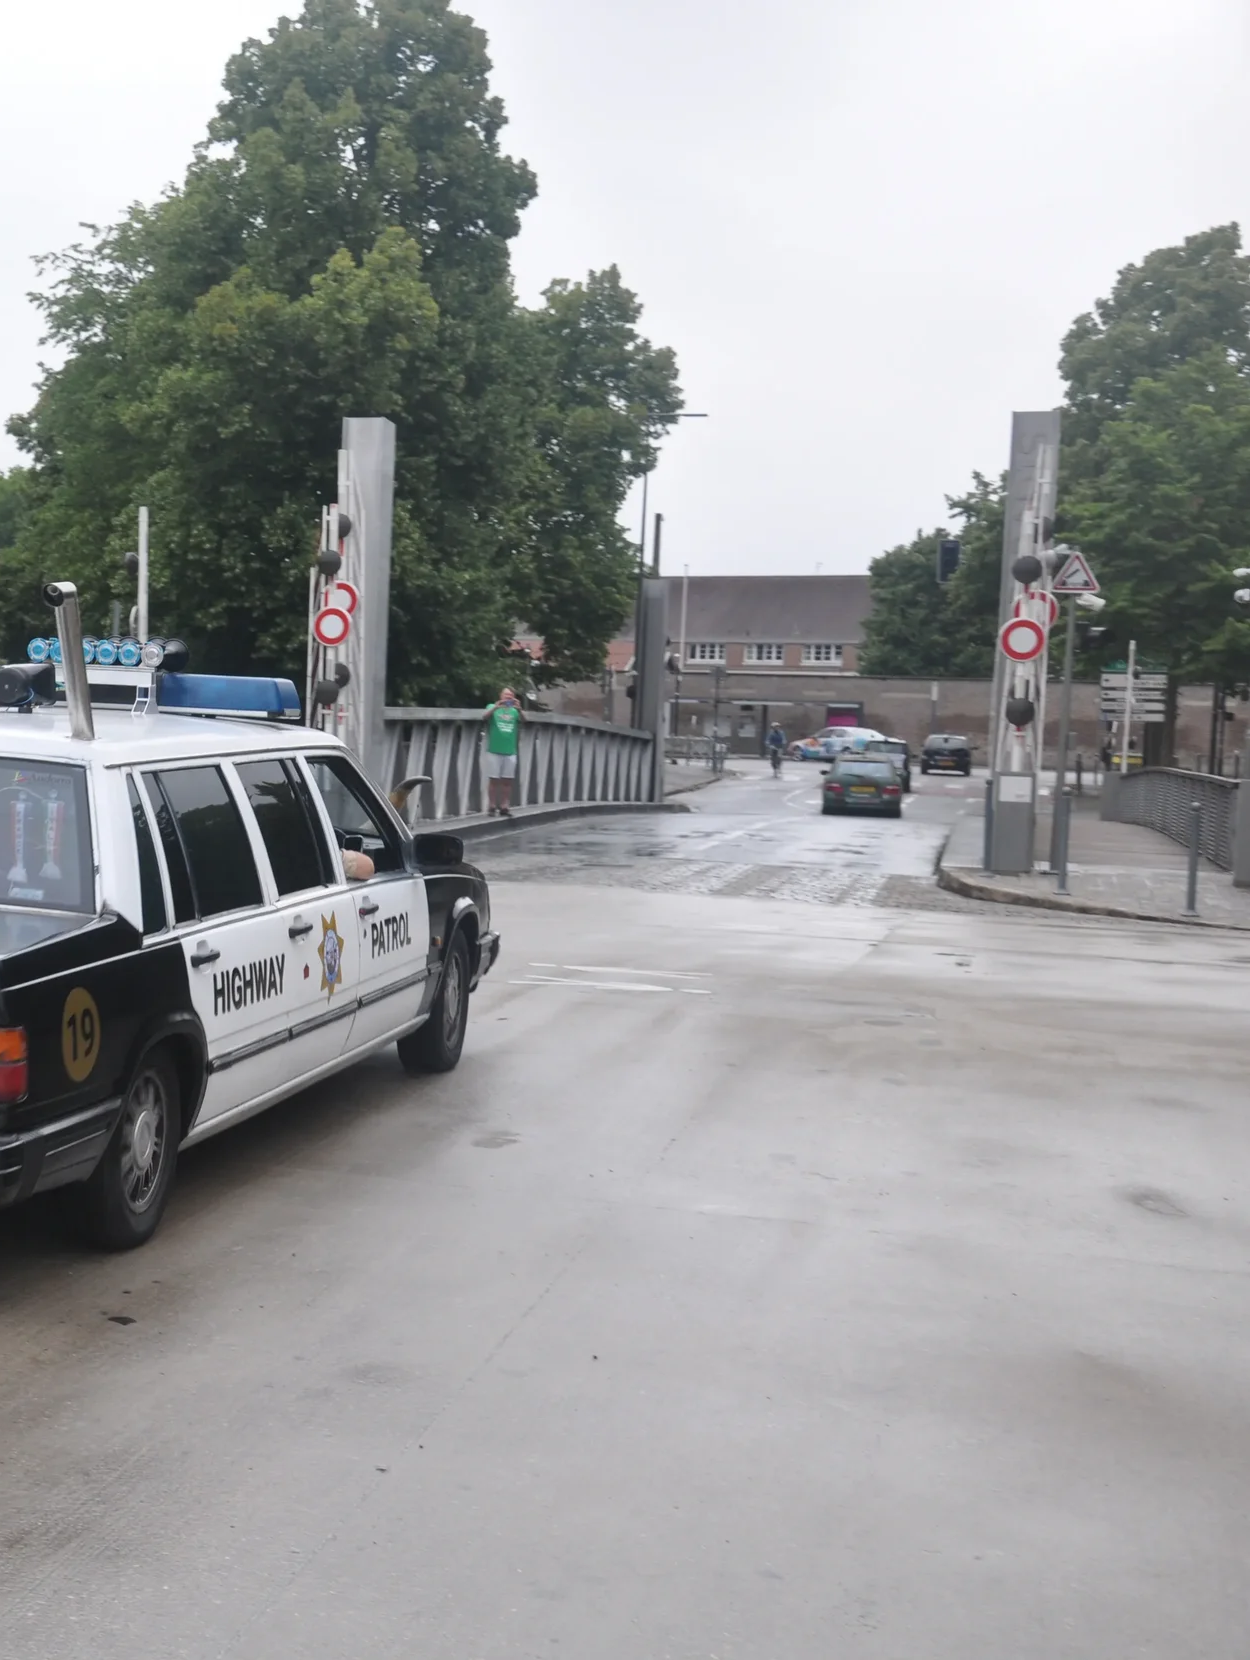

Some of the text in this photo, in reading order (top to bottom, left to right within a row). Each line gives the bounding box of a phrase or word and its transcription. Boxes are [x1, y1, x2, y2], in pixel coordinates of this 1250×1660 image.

[213, 953, 285, 1016] HIGHWAY
[371, 912, 411, 959] PATROL
[67, 1007, 95, 1063] 19
